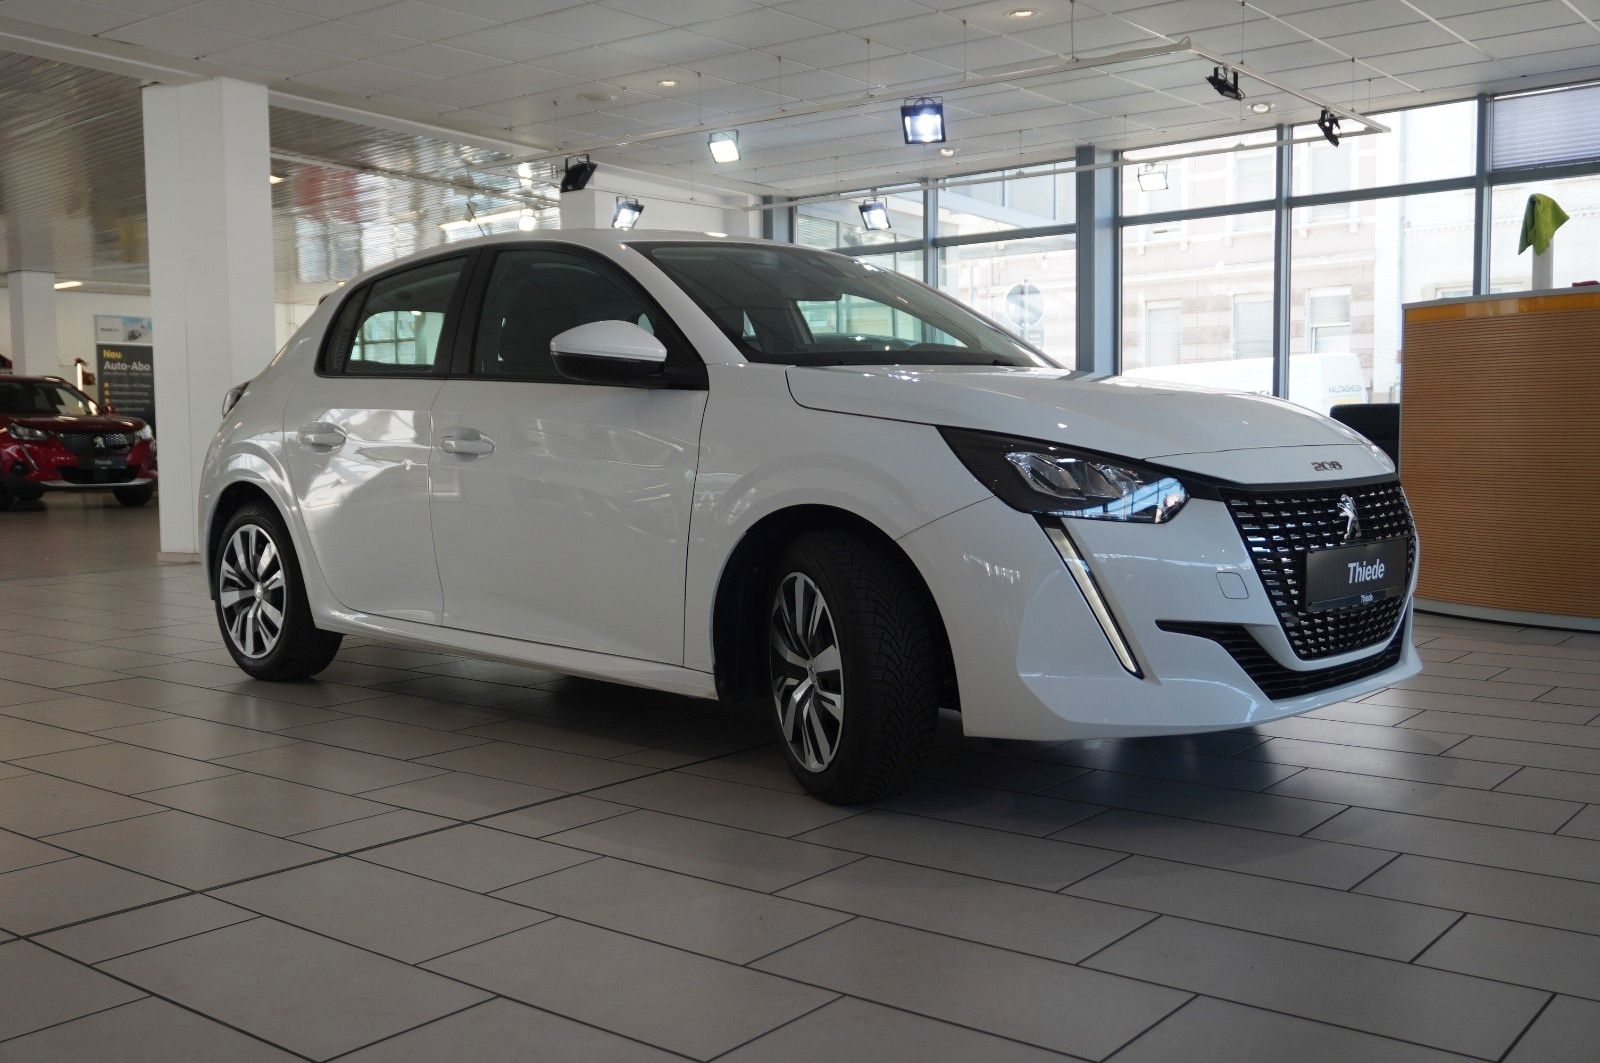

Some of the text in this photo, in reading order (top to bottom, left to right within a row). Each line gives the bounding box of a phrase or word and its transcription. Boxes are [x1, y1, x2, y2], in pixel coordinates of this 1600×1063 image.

[103, 349, 121, 358] Neu
[104, 361, 151, 371] Auto-Abo
[1311, 460, 1343, 471] 208
[1347, 558, 1385, 584] Thiede
